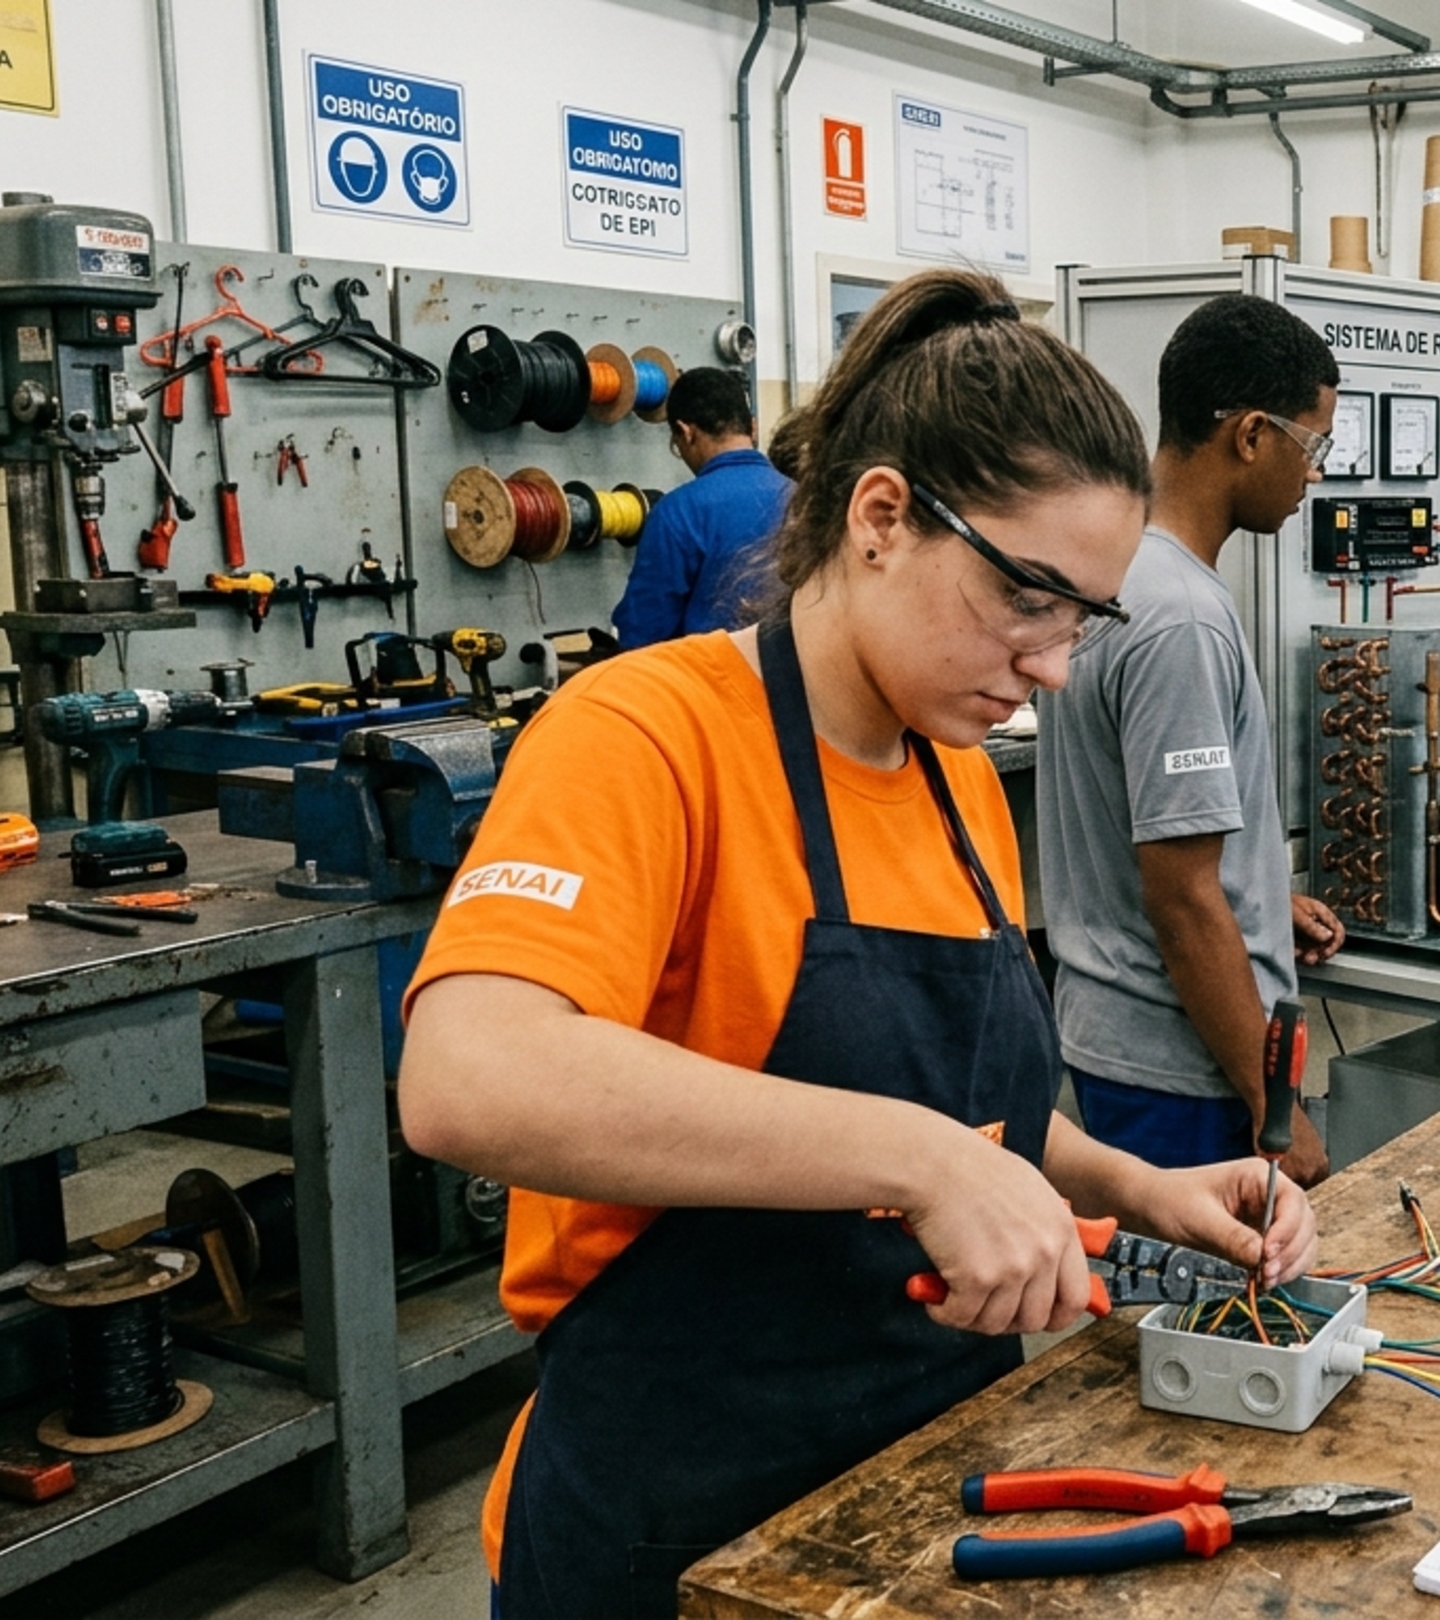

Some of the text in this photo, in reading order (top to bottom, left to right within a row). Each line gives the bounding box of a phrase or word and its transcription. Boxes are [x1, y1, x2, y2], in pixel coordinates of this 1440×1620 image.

[368, 78, 411, 103] USO
[322, 94, 457, 136] OBRIGATÓRIO
[608, 129, 643, 151] USO
[600, 212, 656, 237] DE EPI
[1323, 322, 1403, 353] SISTEMA
[1406, 330, 1429, 355] DE
[457, 868, 565, 897] SENAI
